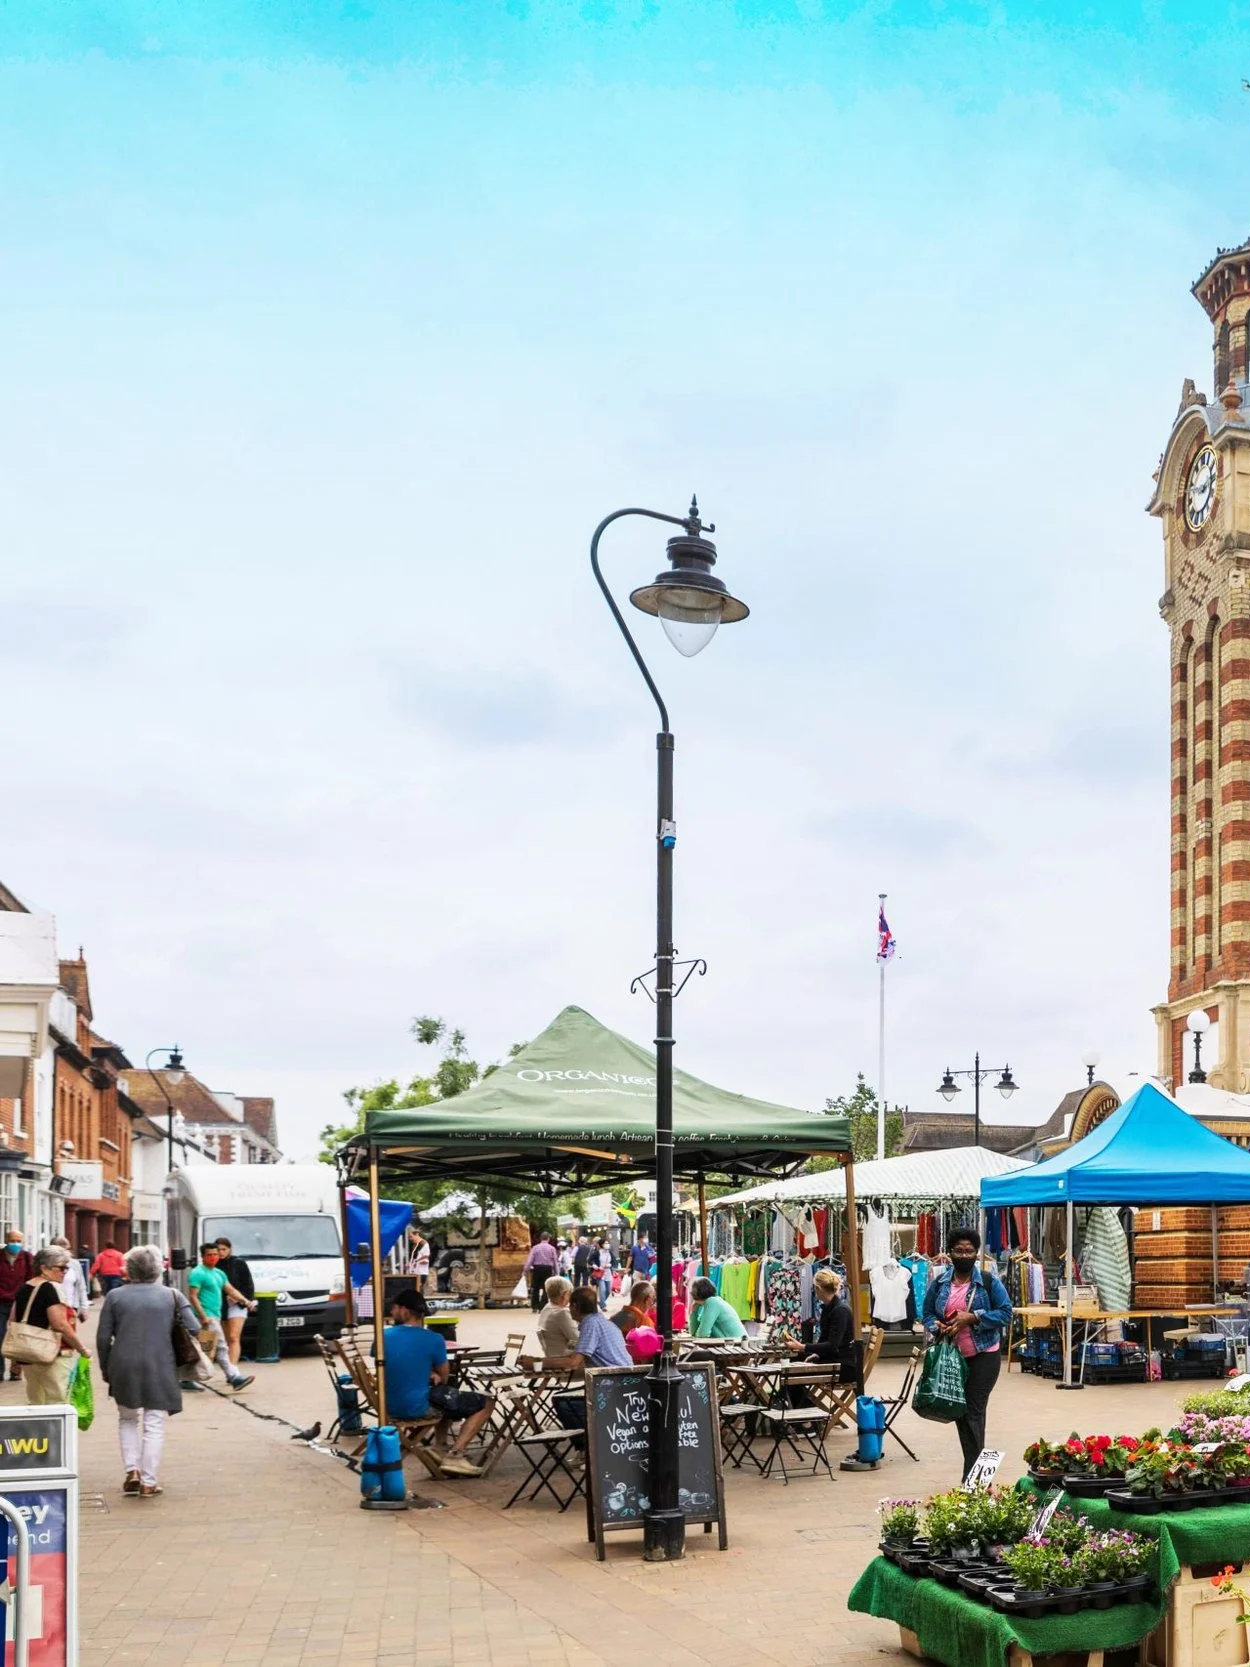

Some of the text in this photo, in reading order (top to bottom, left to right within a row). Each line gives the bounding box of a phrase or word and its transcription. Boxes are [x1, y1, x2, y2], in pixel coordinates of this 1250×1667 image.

[623, 1391, 647, 1412] Try
[606, 1423, 637, 1442] Vegan
[610, 1440, 650, 1454] Options
